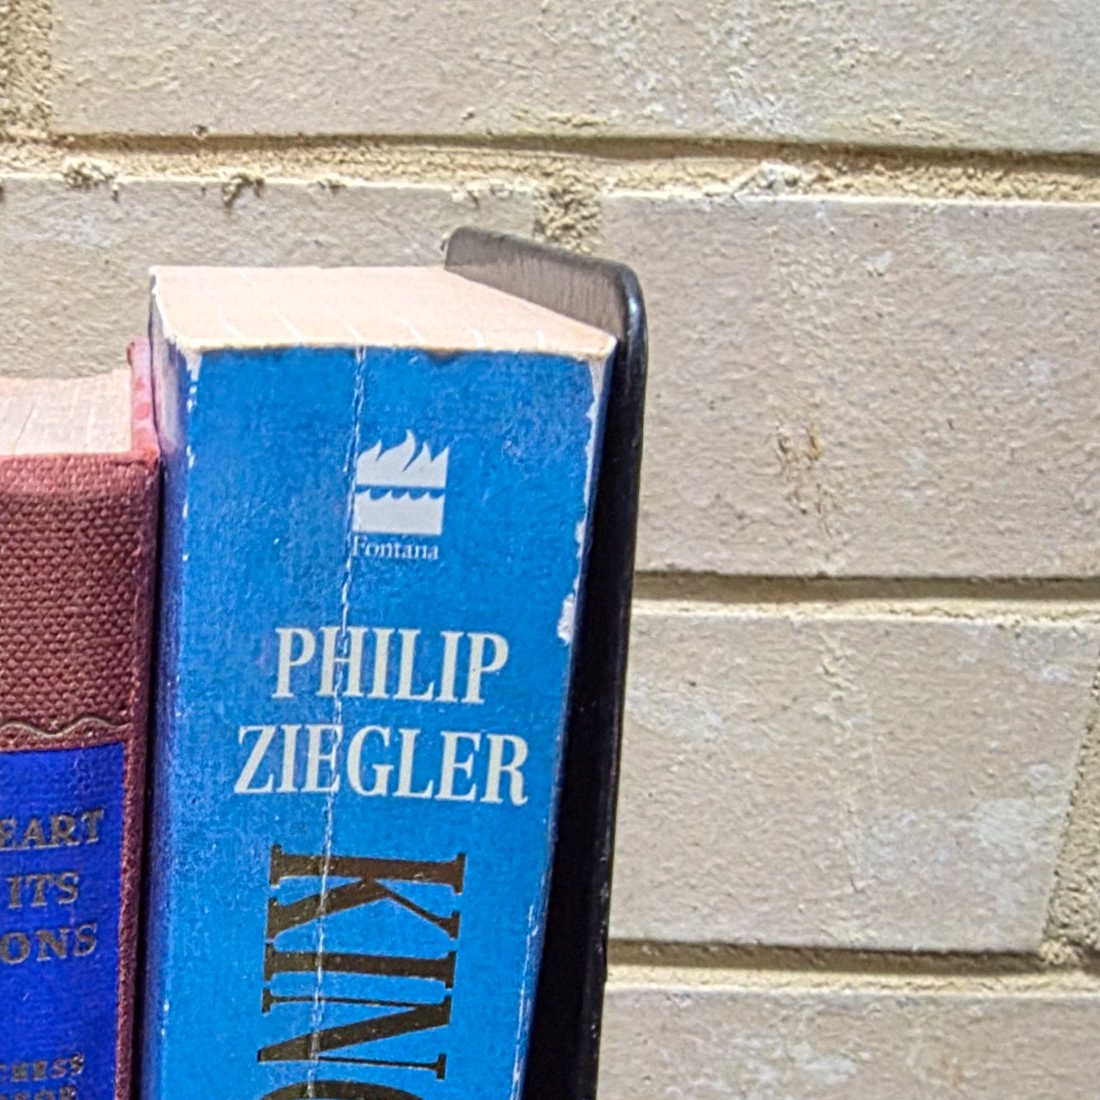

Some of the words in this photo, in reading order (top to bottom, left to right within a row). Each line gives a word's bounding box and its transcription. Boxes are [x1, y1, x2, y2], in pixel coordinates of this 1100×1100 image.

[353, 536, 440, 561] Fontana
[272, 625, 510, 705] PHILIP
[234, 722, 530, 807] ZIEGLER
[6, 871, 80, 909] ITS
